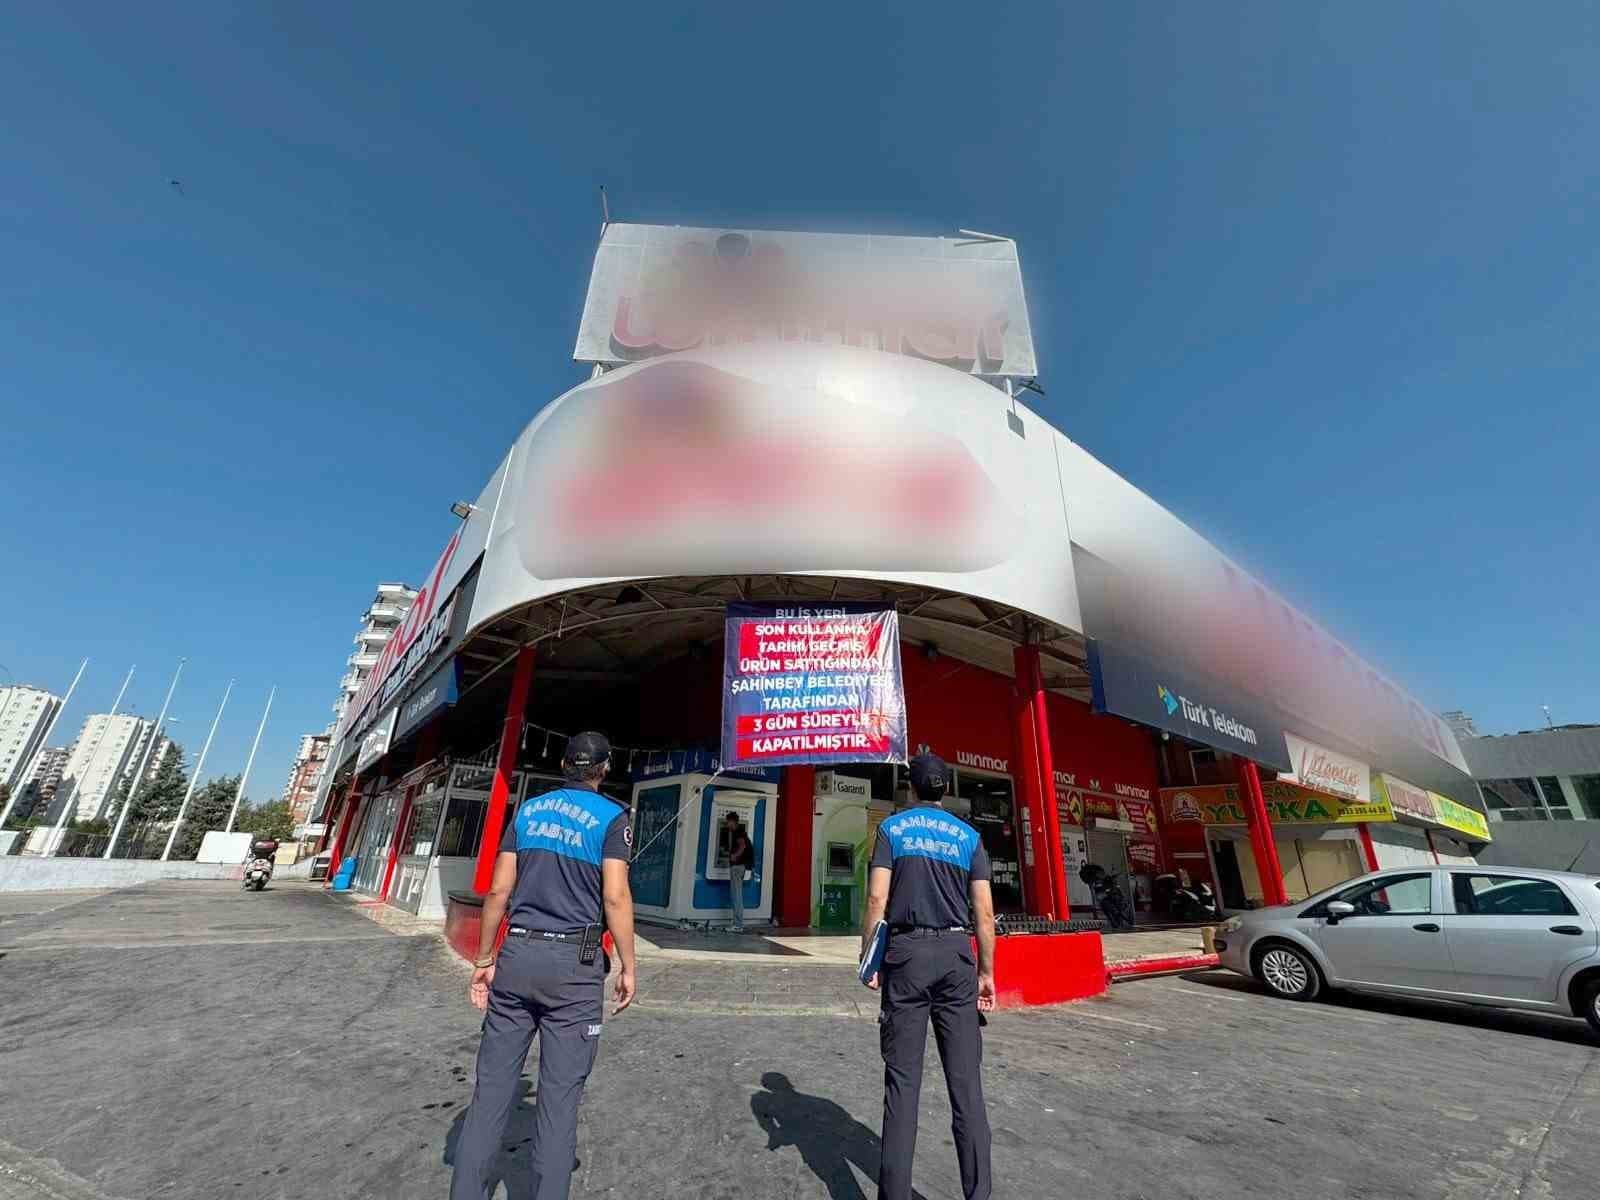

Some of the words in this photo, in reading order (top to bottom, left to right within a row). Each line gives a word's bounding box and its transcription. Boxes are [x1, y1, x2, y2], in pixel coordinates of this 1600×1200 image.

[813, 607, 846, 619] YERİ
[755, 625, 785, 636] SON
[788, 624, 866, 636] KULLANMA
[740, 657, 780, 672] ÜRÜN
[731, 675, 803, 695] ŞAHİNBEY
[763, 694, 860, 710] TARAFINDAN
[753, 719, 762, 731] 3
[765, 715, 797, 731] GÜN
[801, 711, 871, 729] SÜREYLE
[1179, 695, 1209, 727] Türk
[1209, 708, 1257, 745] Telekom
[752, 734, 870, 753] KAPATILMIŞTIR.
[837, 781, 865, 794] Garanti
